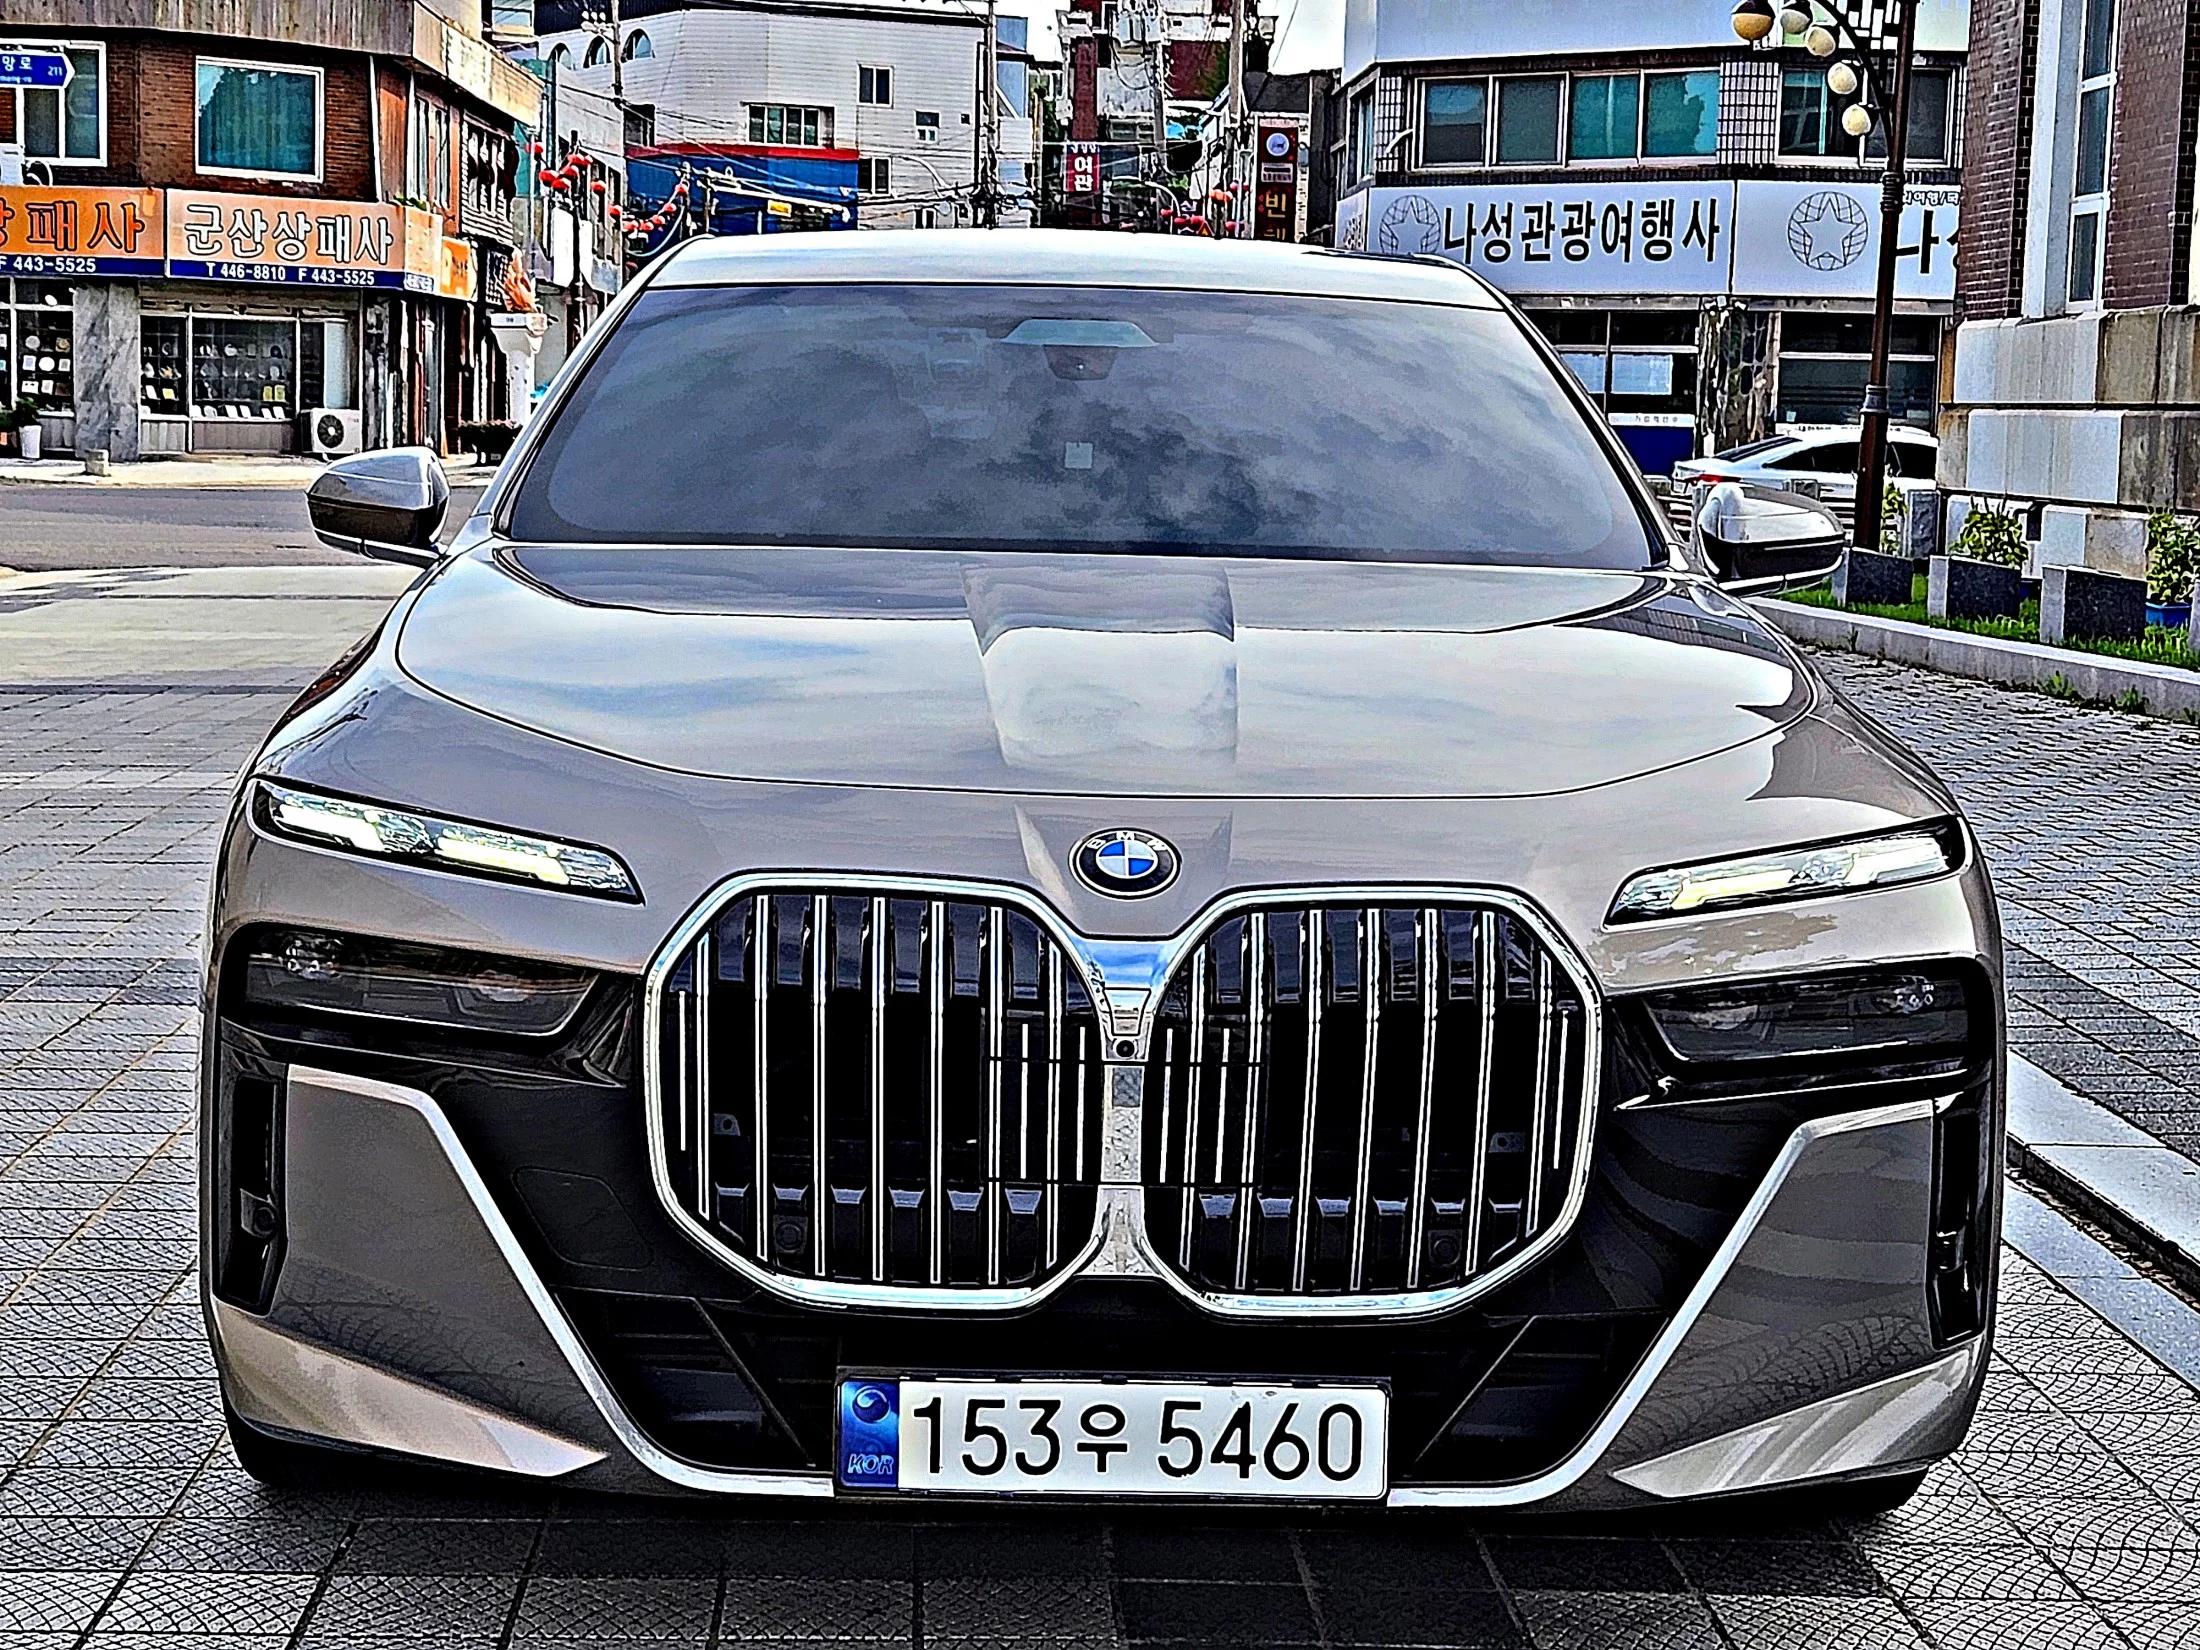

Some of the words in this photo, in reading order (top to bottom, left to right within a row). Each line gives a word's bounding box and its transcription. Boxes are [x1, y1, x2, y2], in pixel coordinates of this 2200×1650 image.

[184, 204, 394, 265] 군산상패사
[1443, 198, 1720, 264] 나성관광여행사
[13, 255, 97, 273] 443-5525
[206, 262, 216, 277] T
[220, 264, 286, 281] 446-8810
[298, 267, 307, 281] F
[311, 270, 375, 286] 443-5525
[1086, 831, 1169, 851] BMW
[1158, 1402, 1362, 1483] 5460
[847, 1453, 894, 1475] KOR
